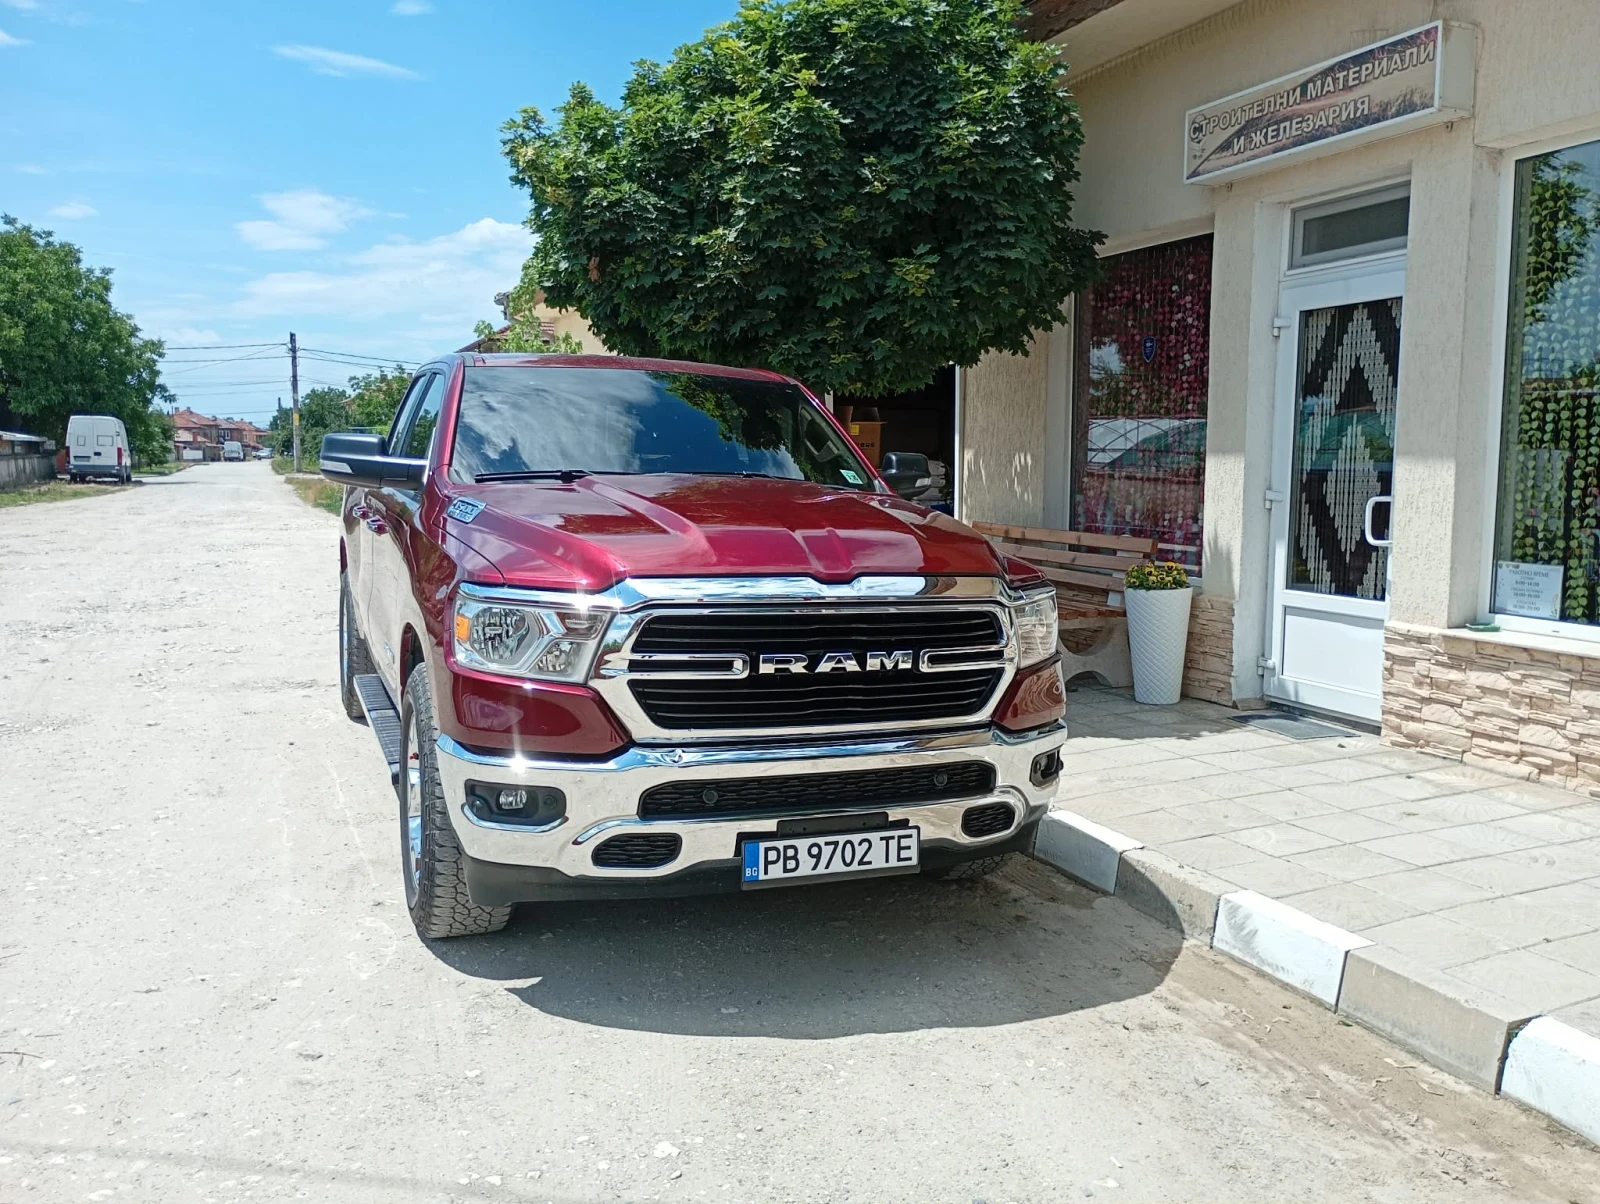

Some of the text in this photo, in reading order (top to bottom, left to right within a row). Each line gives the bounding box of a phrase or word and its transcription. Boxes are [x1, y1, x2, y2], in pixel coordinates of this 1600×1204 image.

[1189, 40, 1436, 141] СТРОИТЕЛНИ МАТЕРИАЛИ
[1231, 95, 1370, 155] И ЖЕЛЕЗАРИЯ
[759, 650, 913, 674] RAM
[745, 867, 758, 877] BG
[764, 834, 913, 875] PB 9702 TE
